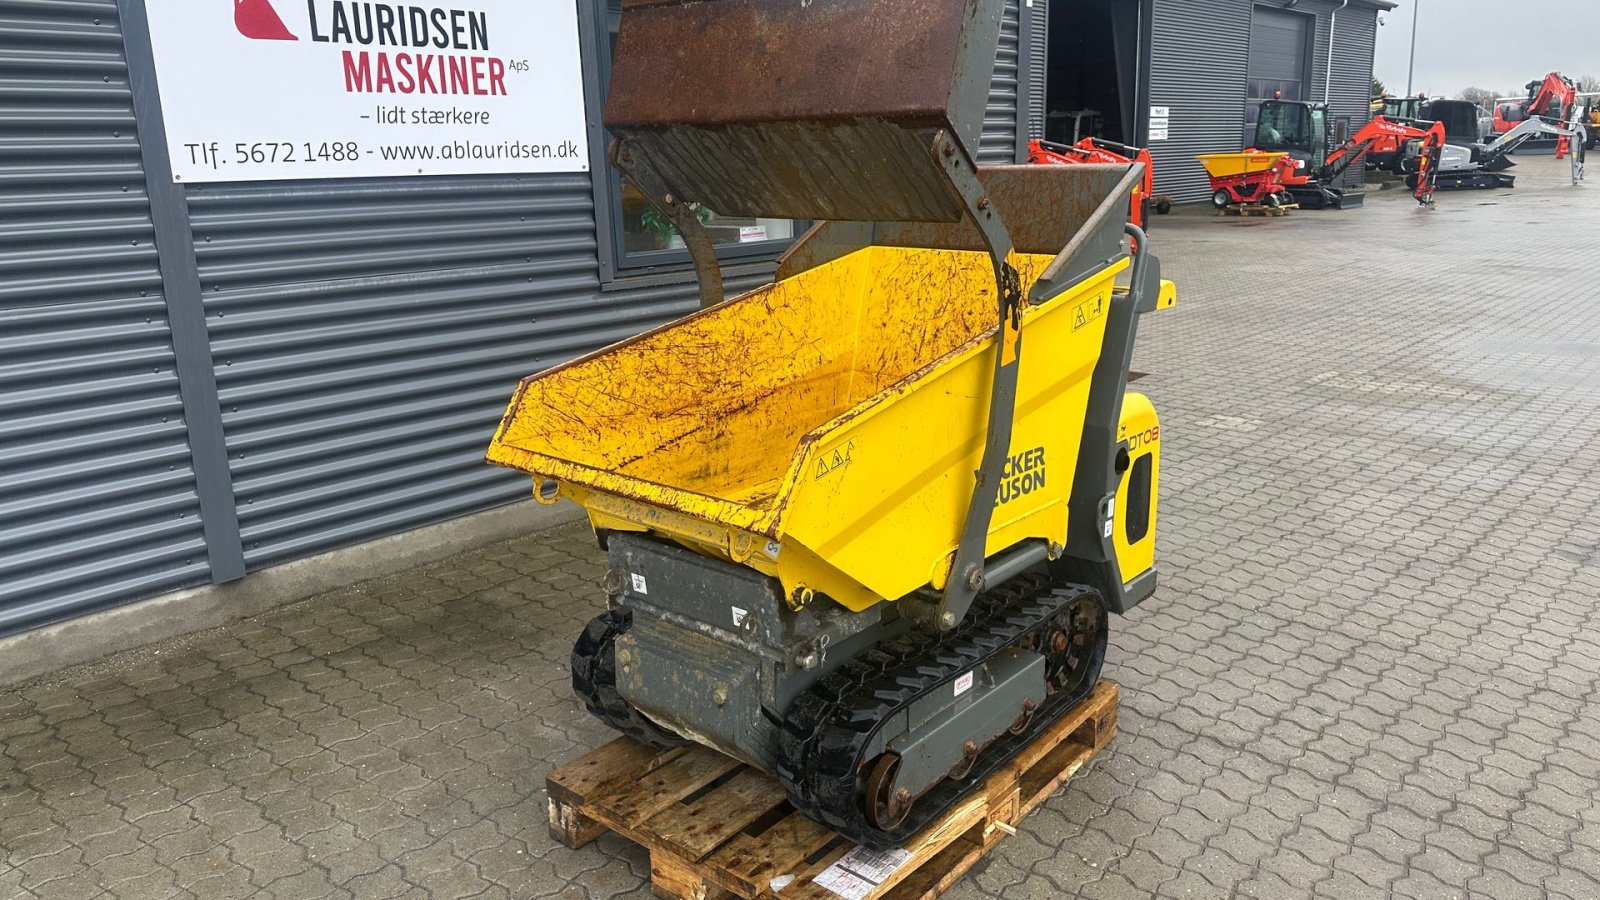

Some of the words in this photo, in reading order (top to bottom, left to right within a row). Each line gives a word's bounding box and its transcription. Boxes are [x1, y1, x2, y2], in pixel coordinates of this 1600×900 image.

[307, 0, 489, 51] LAURIDSEN
[342, 50, 507, 96] MASKINER
[508, 59, 530, 74] ApS
[376, 105, 406, 125] lidt
[411, 107, 490, 125] stærkere
[184, 142, 227, 170] Tlf.
[235, 142, 296, 164] 5672
[303, 141, 359, 162] 1488
[380, 140, 579, 161] www.ablauridsen.dk
